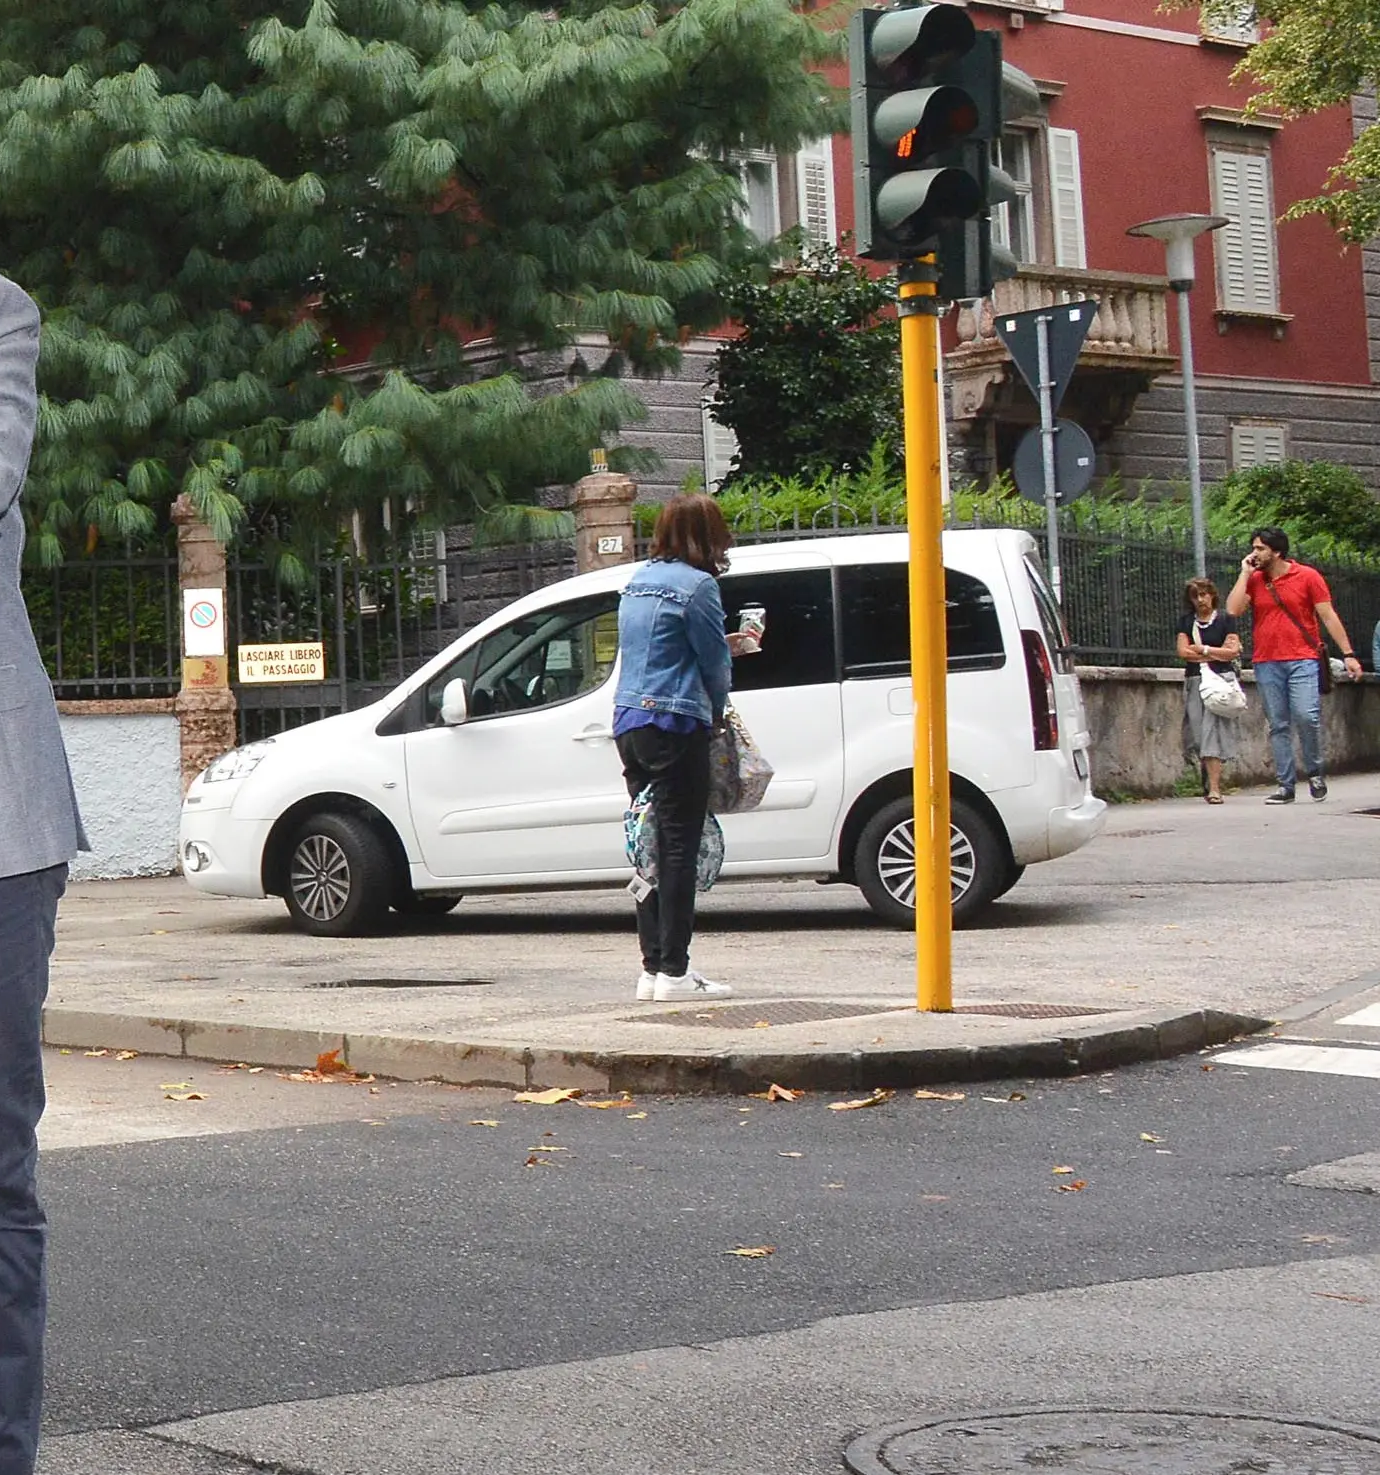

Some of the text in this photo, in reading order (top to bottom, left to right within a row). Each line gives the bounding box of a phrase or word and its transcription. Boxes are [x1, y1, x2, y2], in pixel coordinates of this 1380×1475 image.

[601, 539, 617, 551] 27
[240, 648, 322, 662] LASCIARE LIBERO
[246, 664, 316, 677] IL PASSAGGIO
